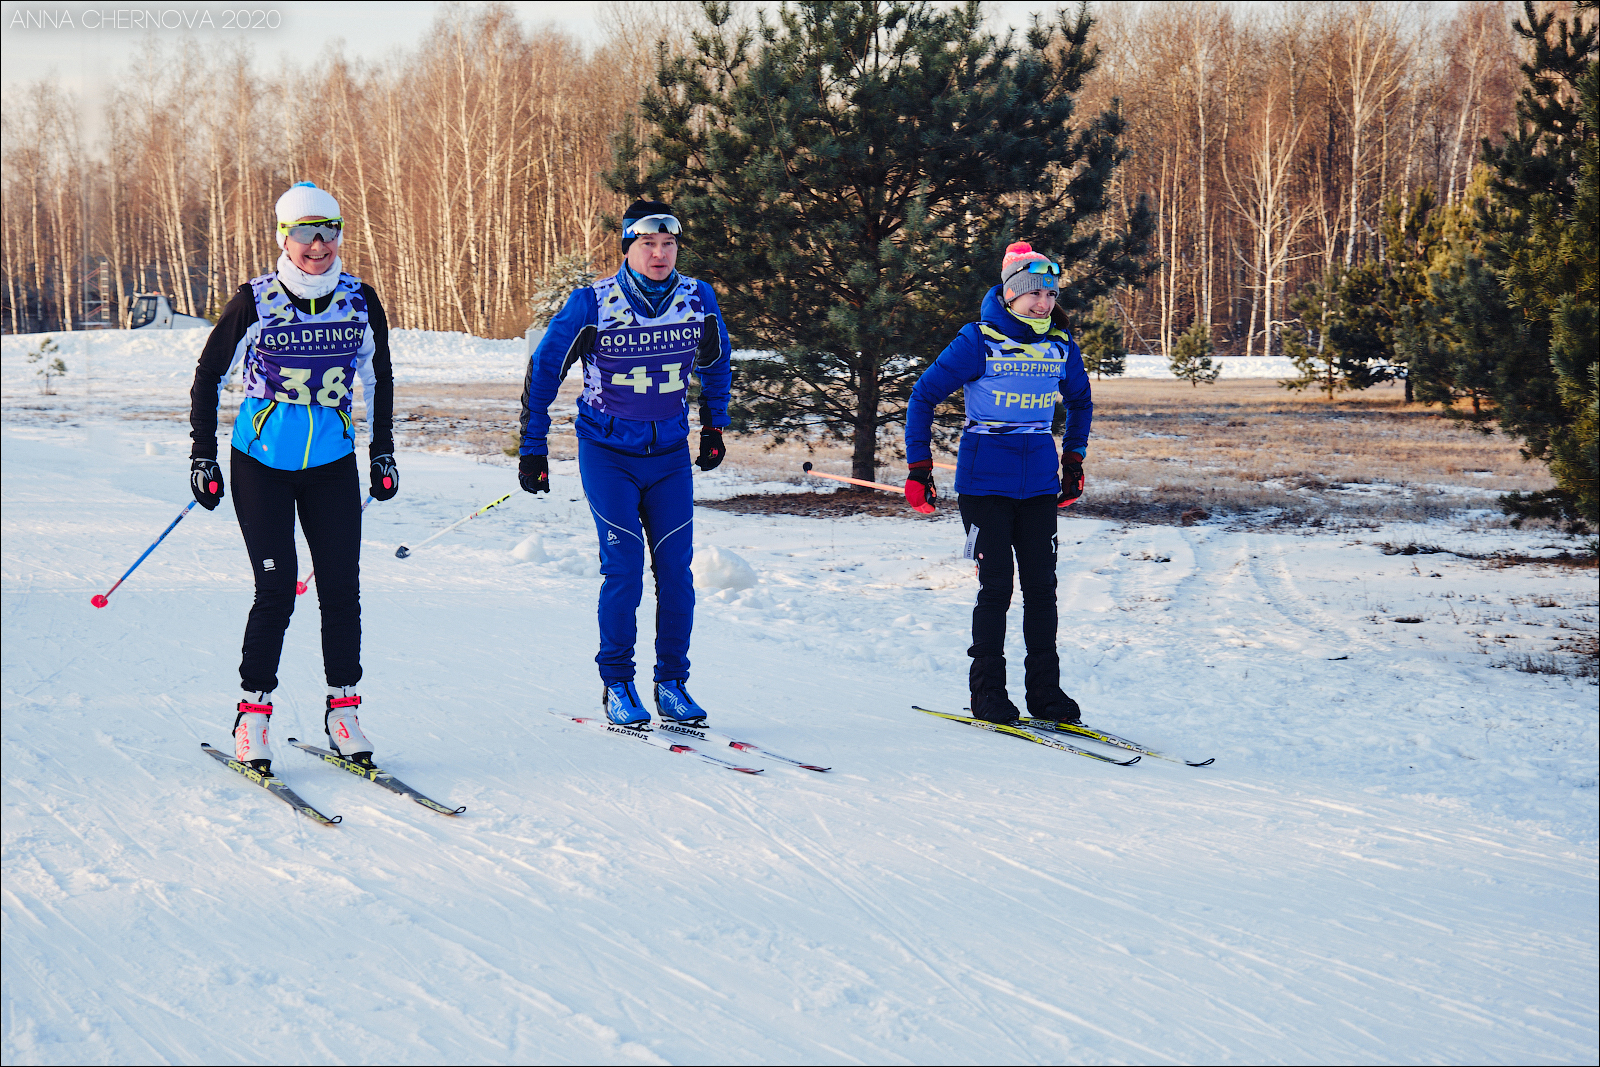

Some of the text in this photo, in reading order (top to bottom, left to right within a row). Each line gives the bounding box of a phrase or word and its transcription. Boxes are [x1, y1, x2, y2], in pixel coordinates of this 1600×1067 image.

[264, 327, 365, 347] GOLDFINCH
[600, 326, 702, 347] GOLDFINCH
[274, 366, 348, 408] 38
[611, 362, 685, 394] 41
[992, 389, 1058, 409] ТРЕНЕР
[607, 686, 630, 722] SPINE
[658, 682, 689, 716] SPINE
[606, 726, 649, 741] MADSHUS
[659, 723, 706, 739] MADSHUS
[228, 759, 262, 784] FISCHER
[324, 754, 367, 777] FISCHER
